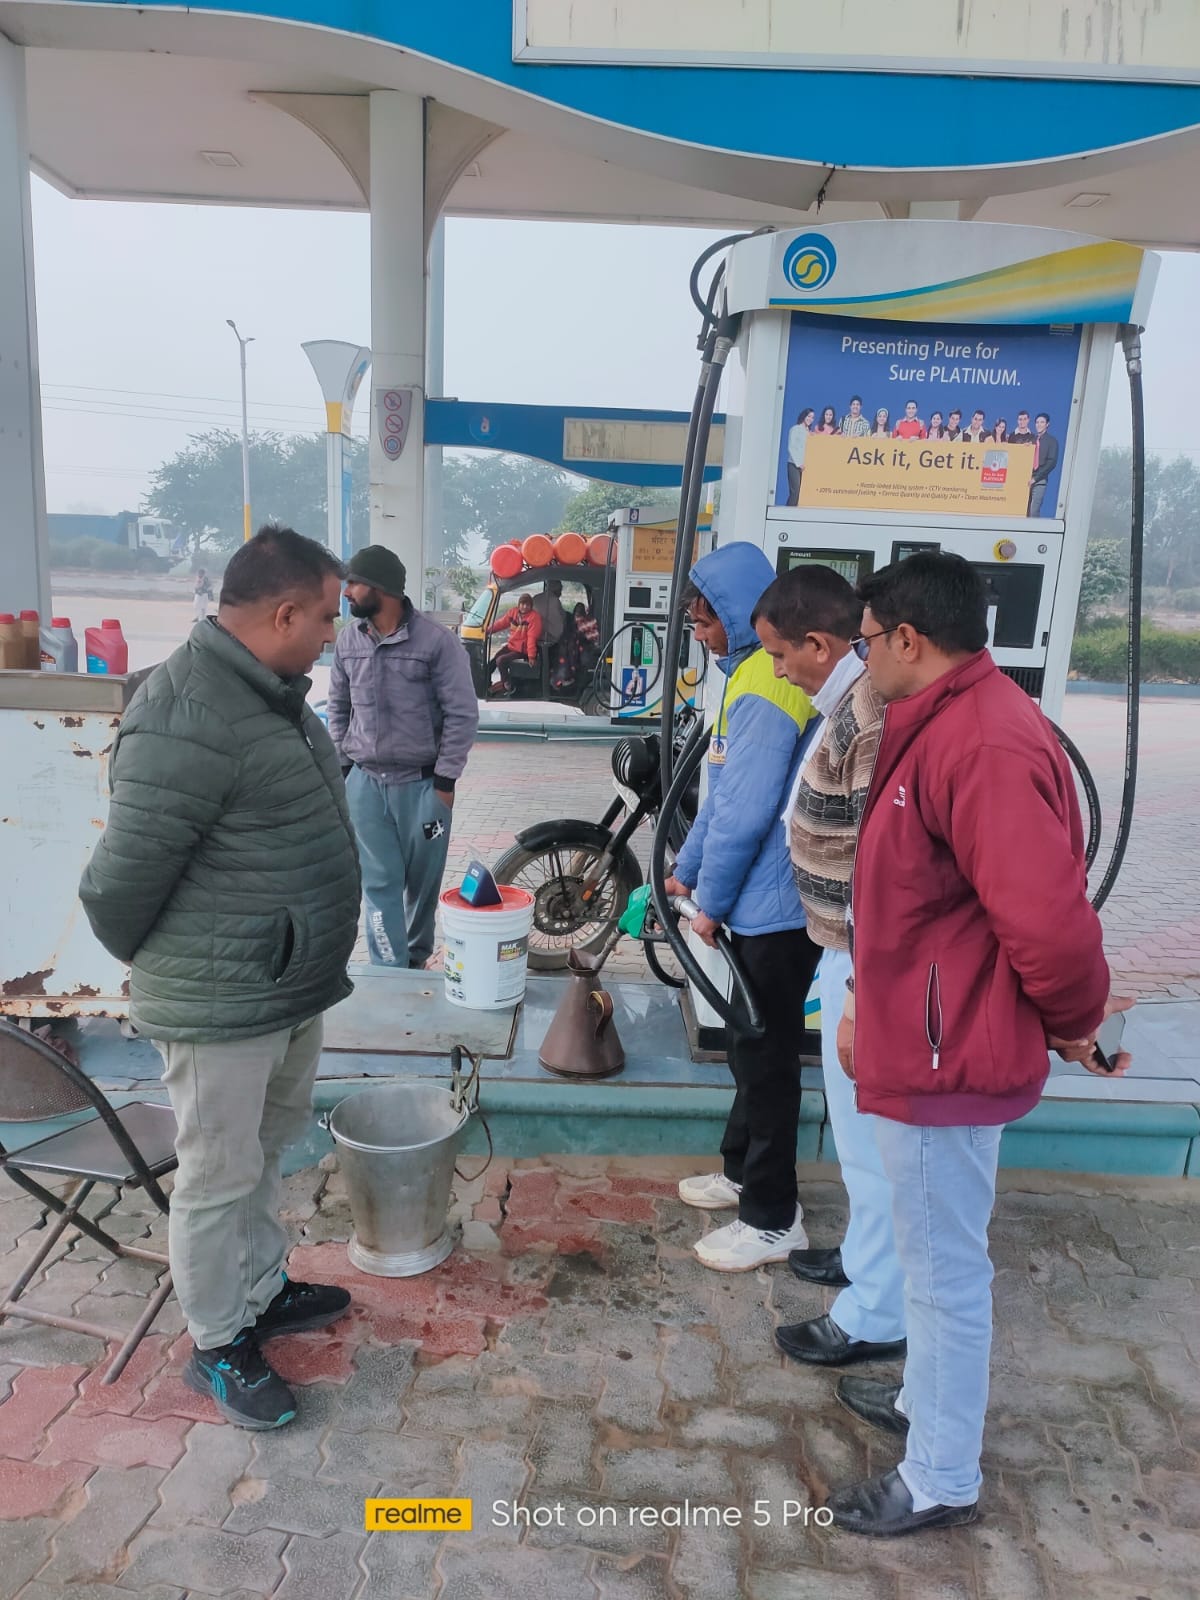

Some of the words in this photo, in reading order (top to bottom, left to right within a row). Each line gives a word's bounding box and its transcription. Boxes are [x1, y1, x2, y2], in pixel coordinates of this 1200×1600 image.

[841, 336, 930, 361] Presenting
[933, 341, 972, 359] Pure
[975, 342, 1000, 360] for
[888, 364, 926, 382] Sure
[929, 366, 1021, 387] PLATINUM.
[847, 447, 885, 466] Ask
[892, 449, 911, 471] it,
[919, 450, 955, 470] Get
[960, 452, 980, 470] it.
